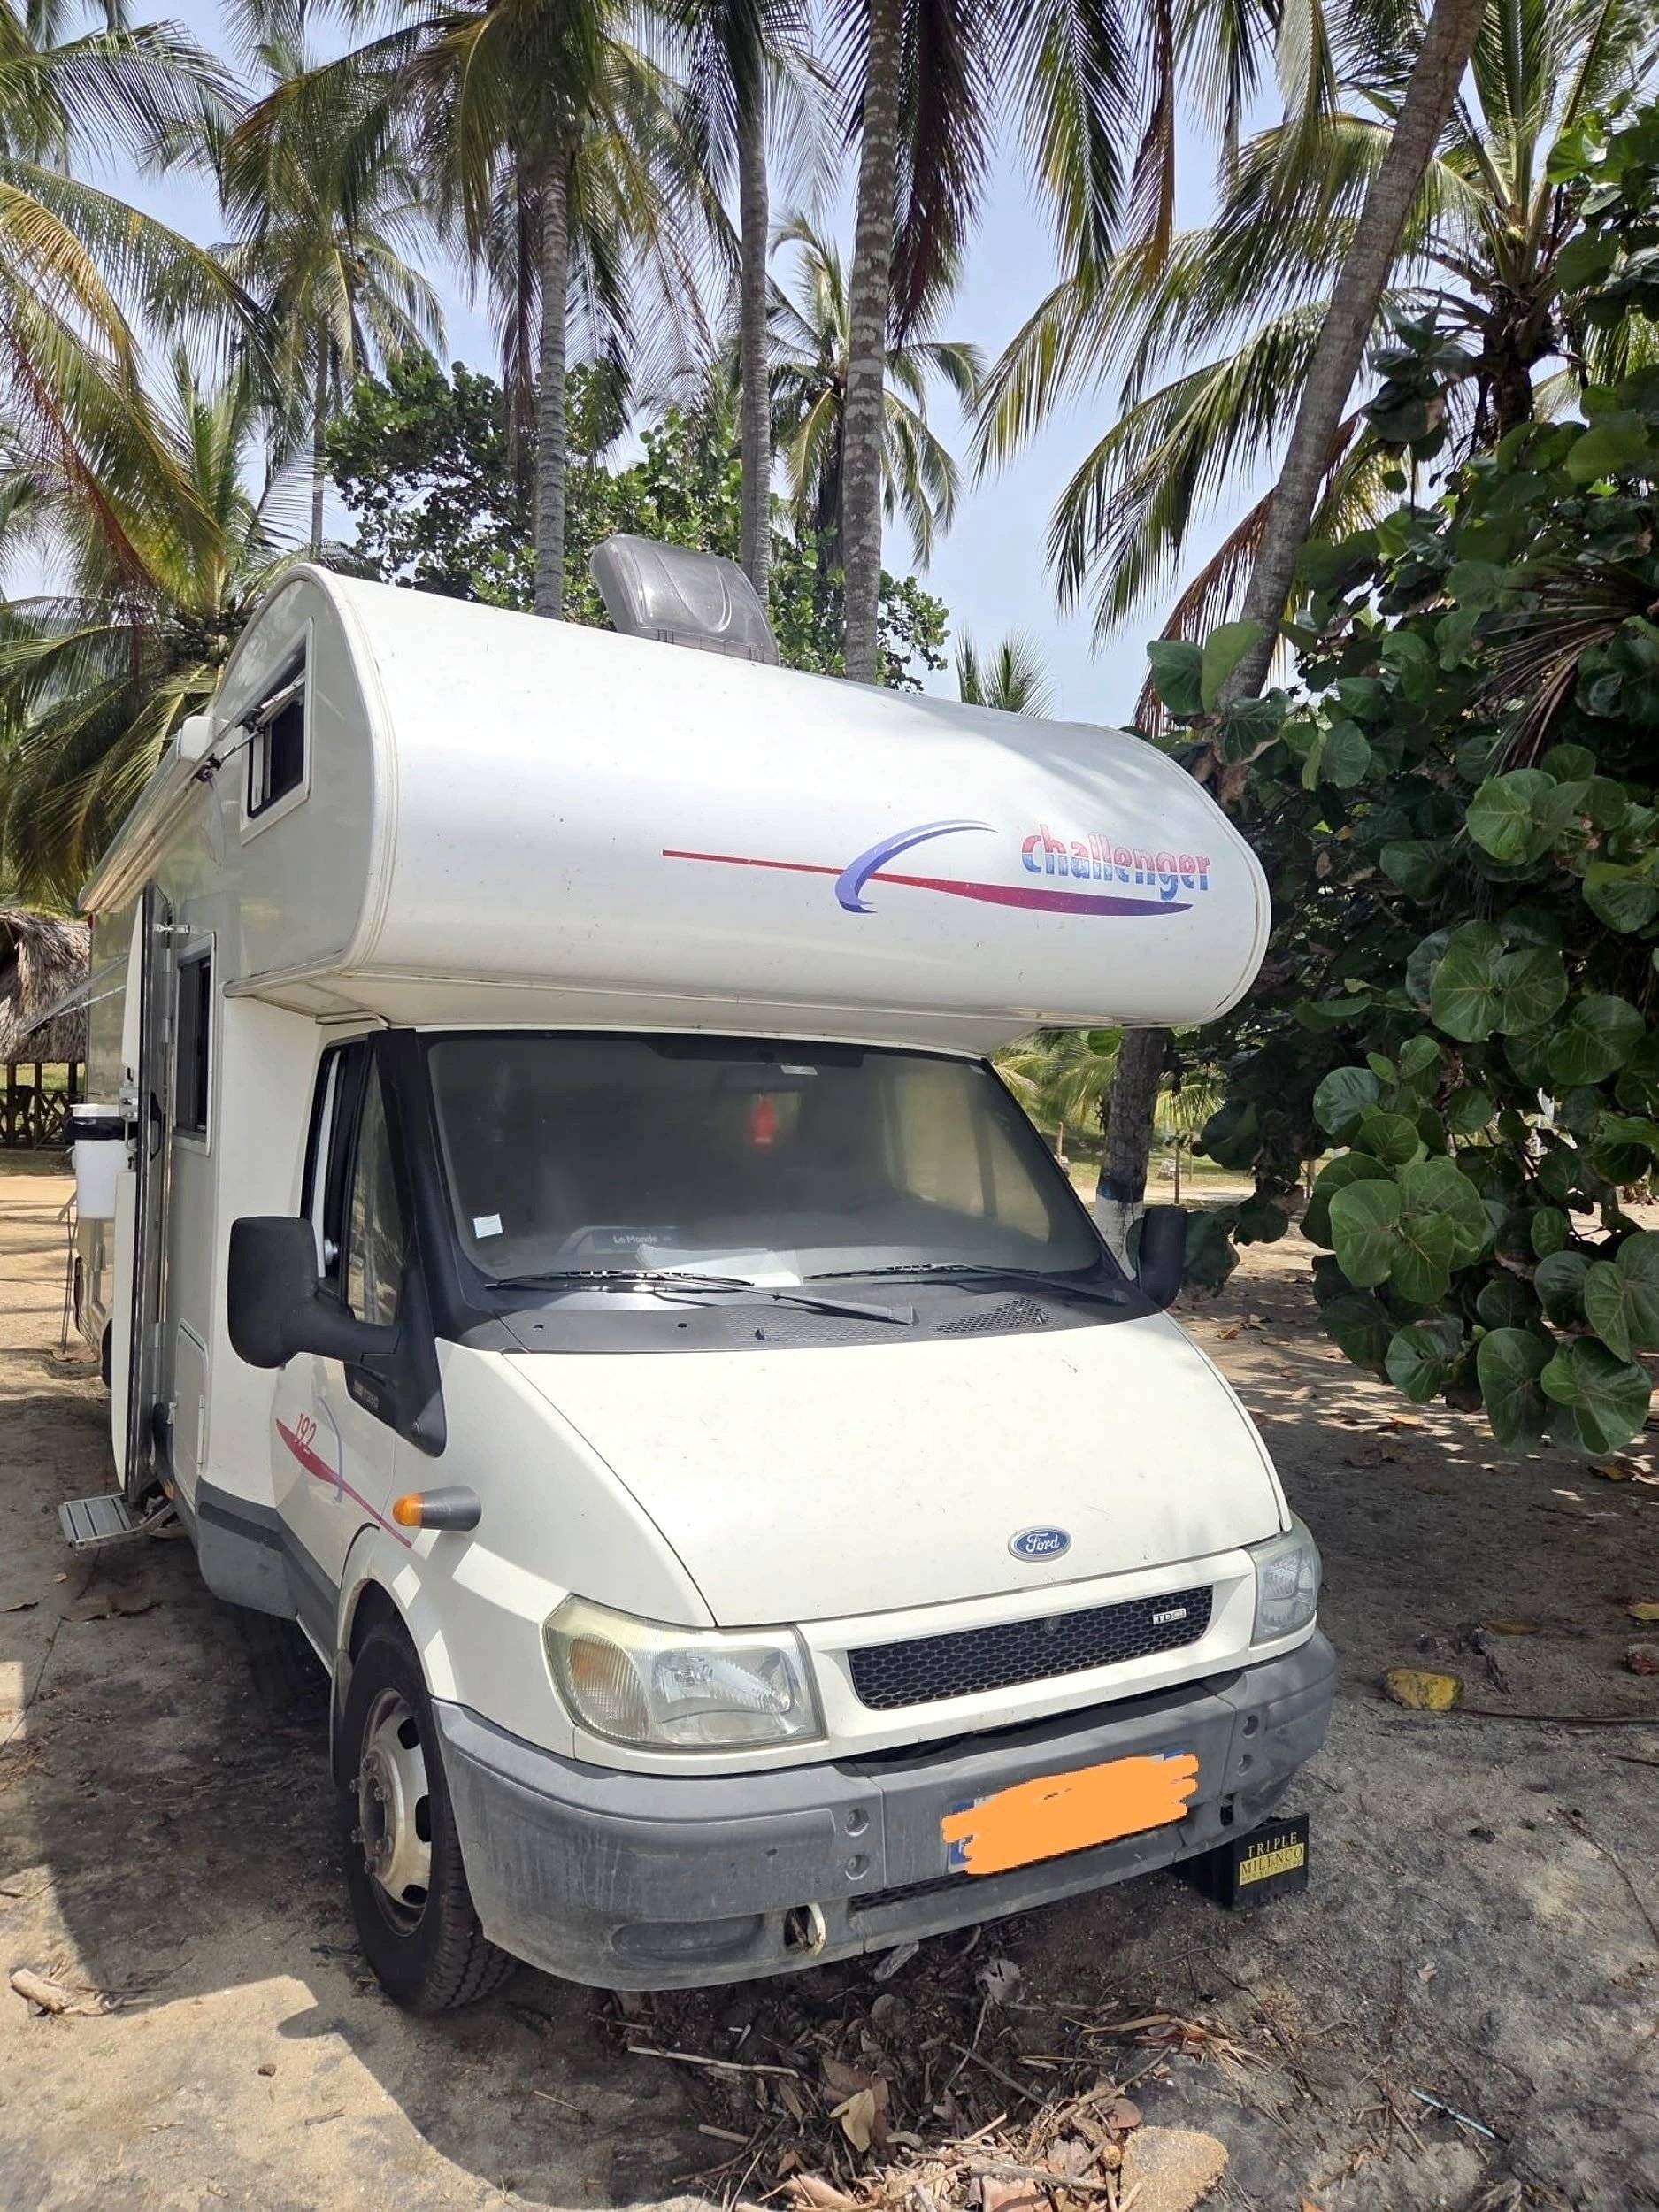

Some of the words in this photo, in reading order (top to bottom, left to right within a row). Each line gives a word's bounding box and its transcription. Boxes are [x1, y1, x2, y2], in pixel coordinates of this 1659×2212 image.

[1026, 1532, 1060, 1553] Ford
[1247, 1832, 1297, 1858] TRIPLE
[1241, 1845, 1302, 1876] MILENCO
